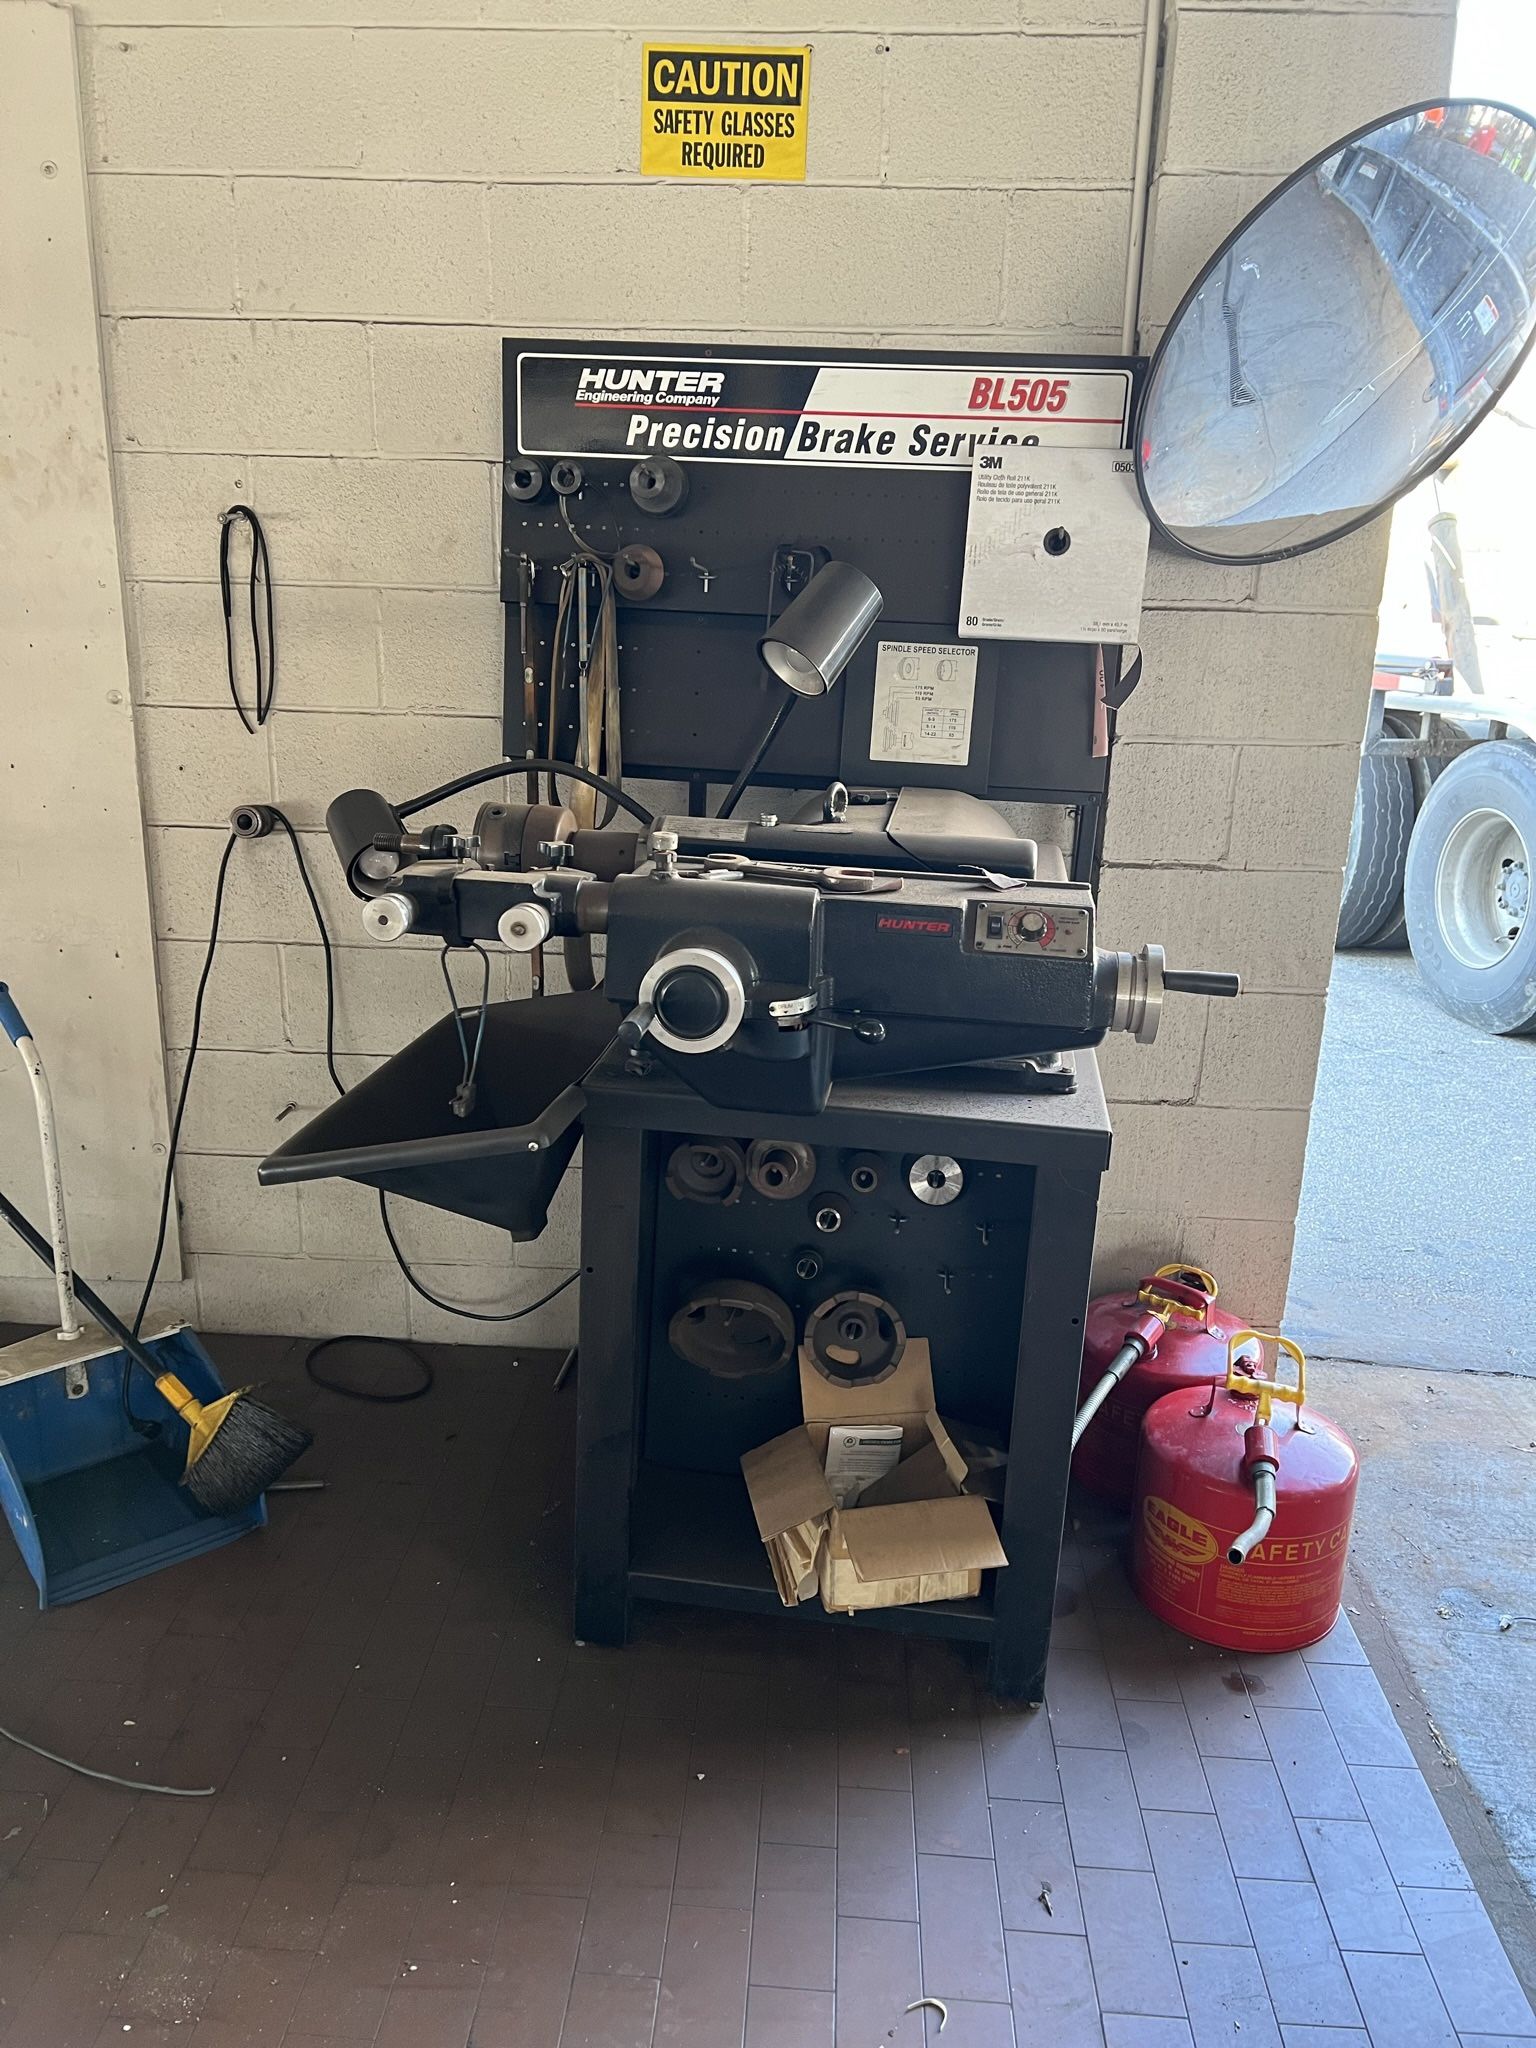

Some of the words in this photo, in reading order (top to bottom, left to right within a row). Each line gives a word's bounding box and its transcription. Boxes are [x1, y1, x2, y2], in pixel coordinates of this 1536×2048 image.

[653, 58, 798, 98] CAUTION
[653, 108, 714, 135] SAFETY
[721, 110, 795, 138] GLASSES
[681, 141, 765, 171] REQUIRED
[578, 367, 726, 394] HUNTER
[575, 389, 653, 405] Engineering
[655, 391, 720, 407] Company
[967, 377, 1071, 413] BL505
[625, 414, 785, 452] Precision
[797, 420, 897, 456] Brake
[979, 456, 1003, 469] 3M
[966, 616, 978, 626] 80
[882, 644, 912, 653] SPINDLE
[913, 646, 937, 655] SPEED
[938, 646, 976, 656] SELECTOR
[878, 917, 951, 932] HUNTER
[1147, 1497, 1208, 1548] EAGLE
[1250, 1536, 1326, 1561] AFETY
